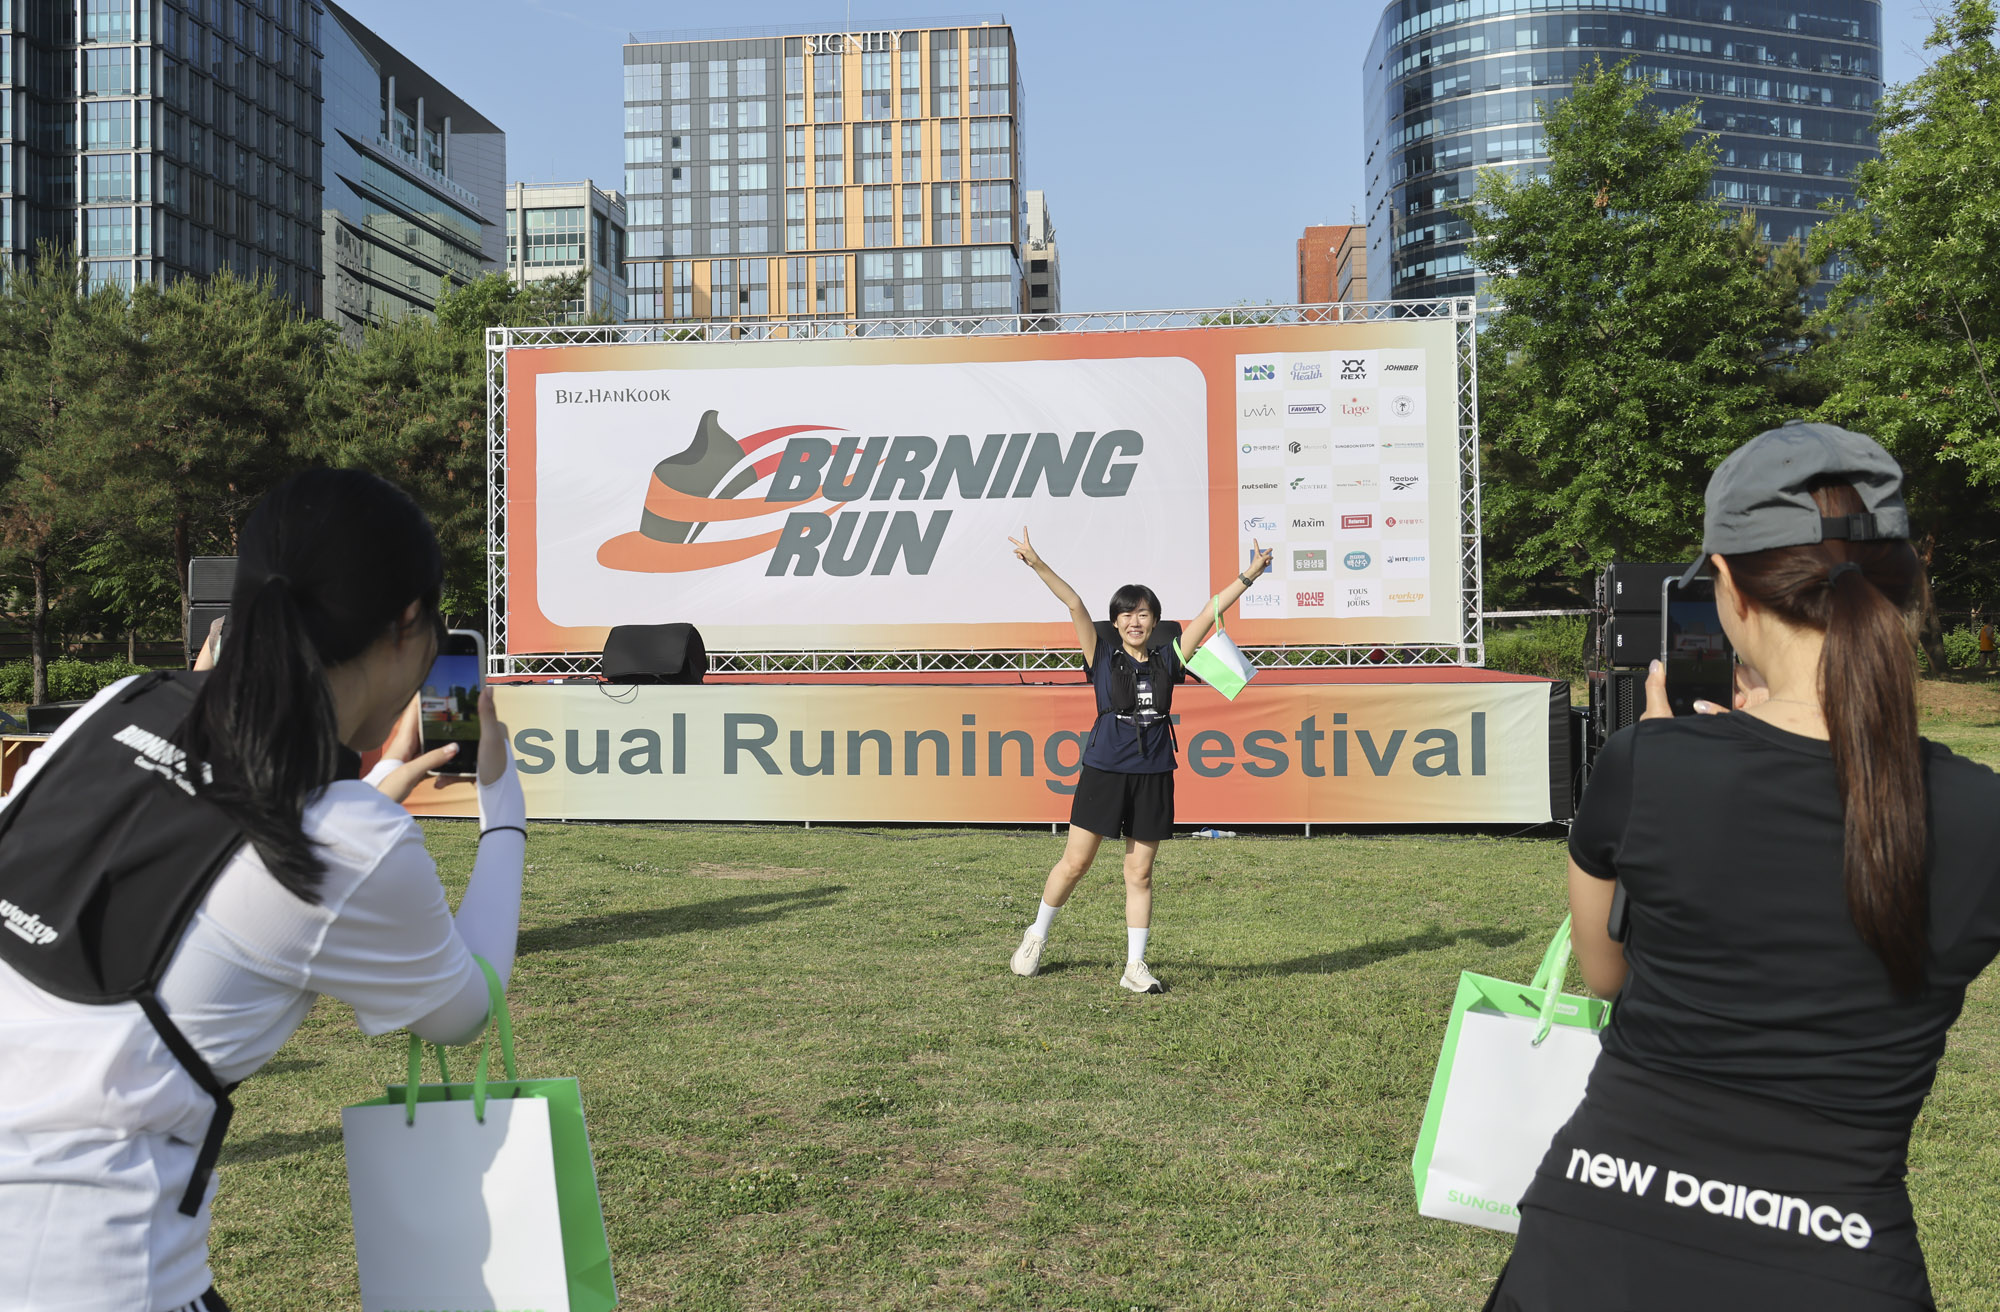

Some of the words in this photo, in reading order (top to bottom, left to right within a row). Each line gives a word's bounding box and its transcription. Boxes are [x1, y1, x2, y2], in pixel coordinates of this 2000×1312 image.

[805, 29, 904, 55] SIGNITY
[1293, 362, 1321, 372] Choco
[1290, 369, 1323, 381] Health
[764, 429, 1144, 502] BURNING
[1241, 482, 1279, 490] nutseline
[1292, 517, 1325, 528] Maxim
[765, 509, 953, 577] RUN
[1295, 559, 1325, 569] 동원샘물
[1245, 594, 1280, 606] 비즈한국
[1296, 592, 1325, 607] 일요신문
[1347, 599, 1371, 608] JOURS
[514, 712, 686, 776] sual
[723, 713, 1092, 796] Running
[1168, 711, 1487, 778] estival
[1565, 1148, 1658, 1197] new
[1664, 1170, 1873, 1250] balance
